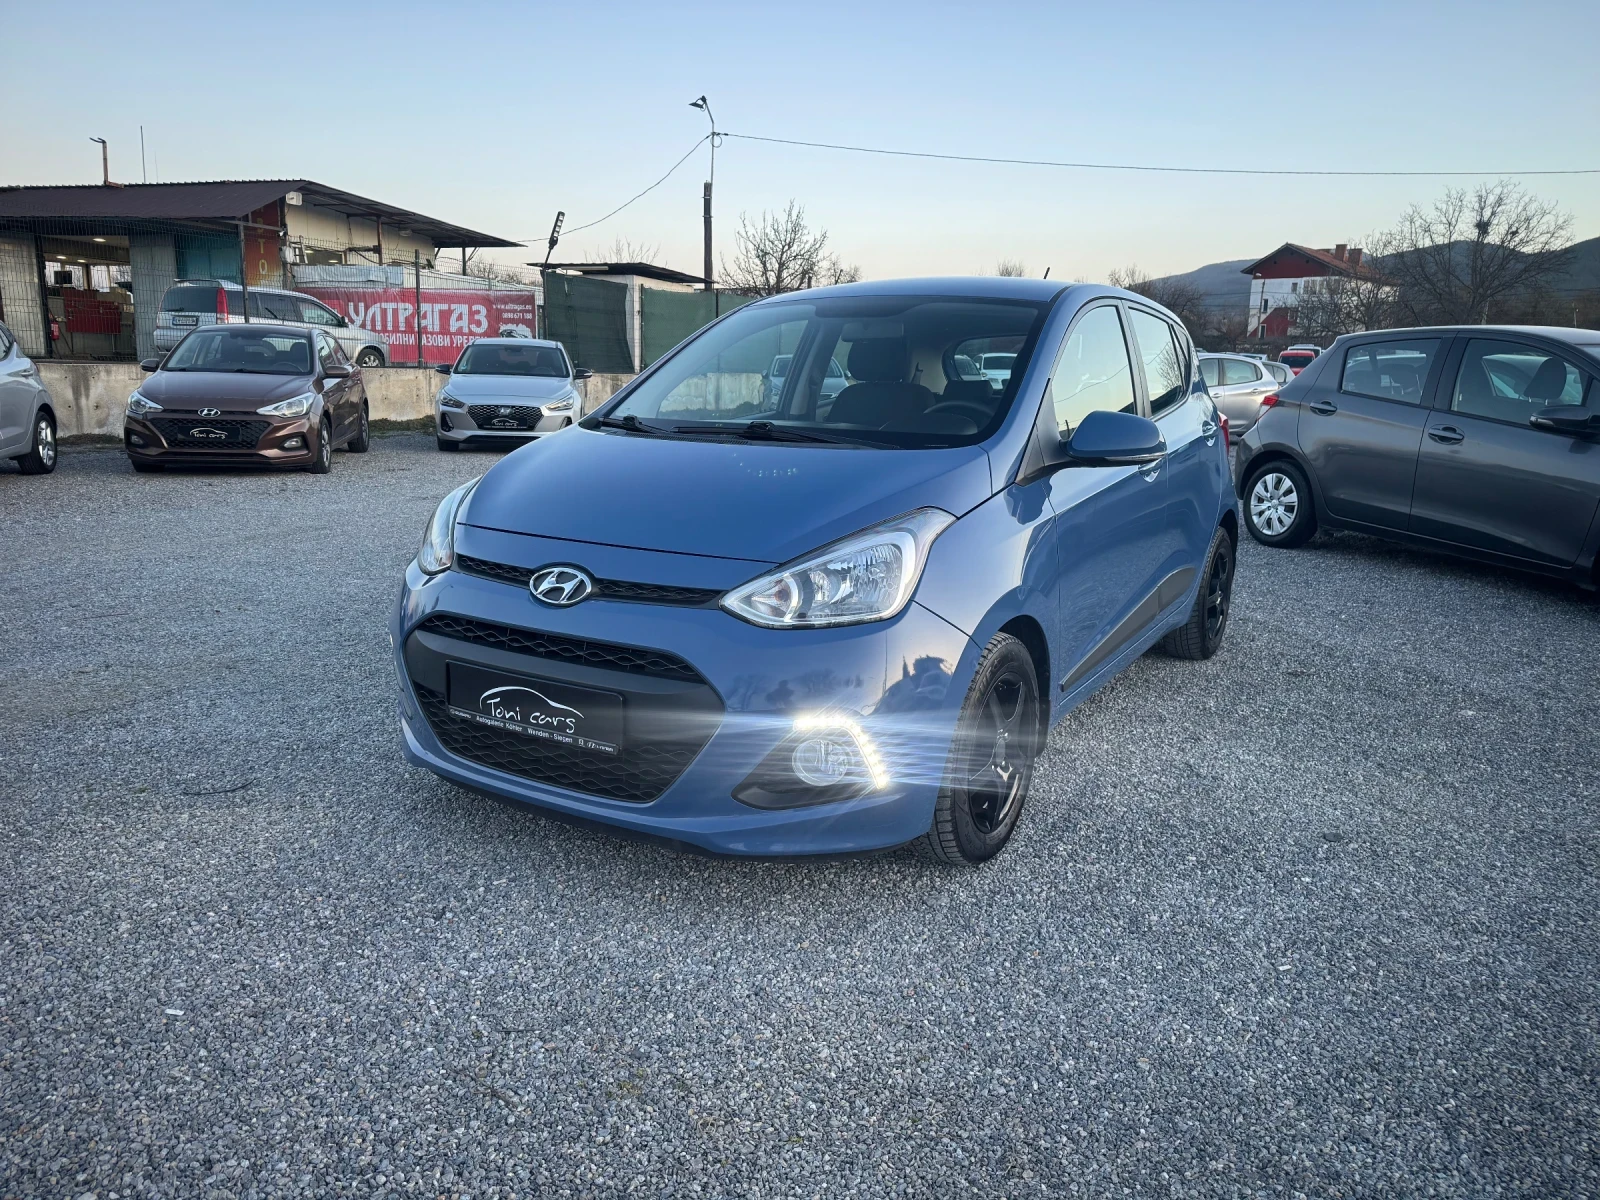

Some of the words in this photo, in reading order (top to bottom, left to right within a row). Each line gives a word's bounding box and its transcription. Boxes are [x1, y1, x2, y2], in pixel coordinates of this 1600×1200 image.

[348, 302, 489, 333] УЛТРАГАЗ
[476, 715, 504, 728] Autogalerie
[505, 722, 523, 732] Köhler
[527, 727, 549, 738] Wenden
[553, 733, 573, 743] Siegen
[486, 697, 521, 720] Toni
[529, 712, 576, 734] cars
